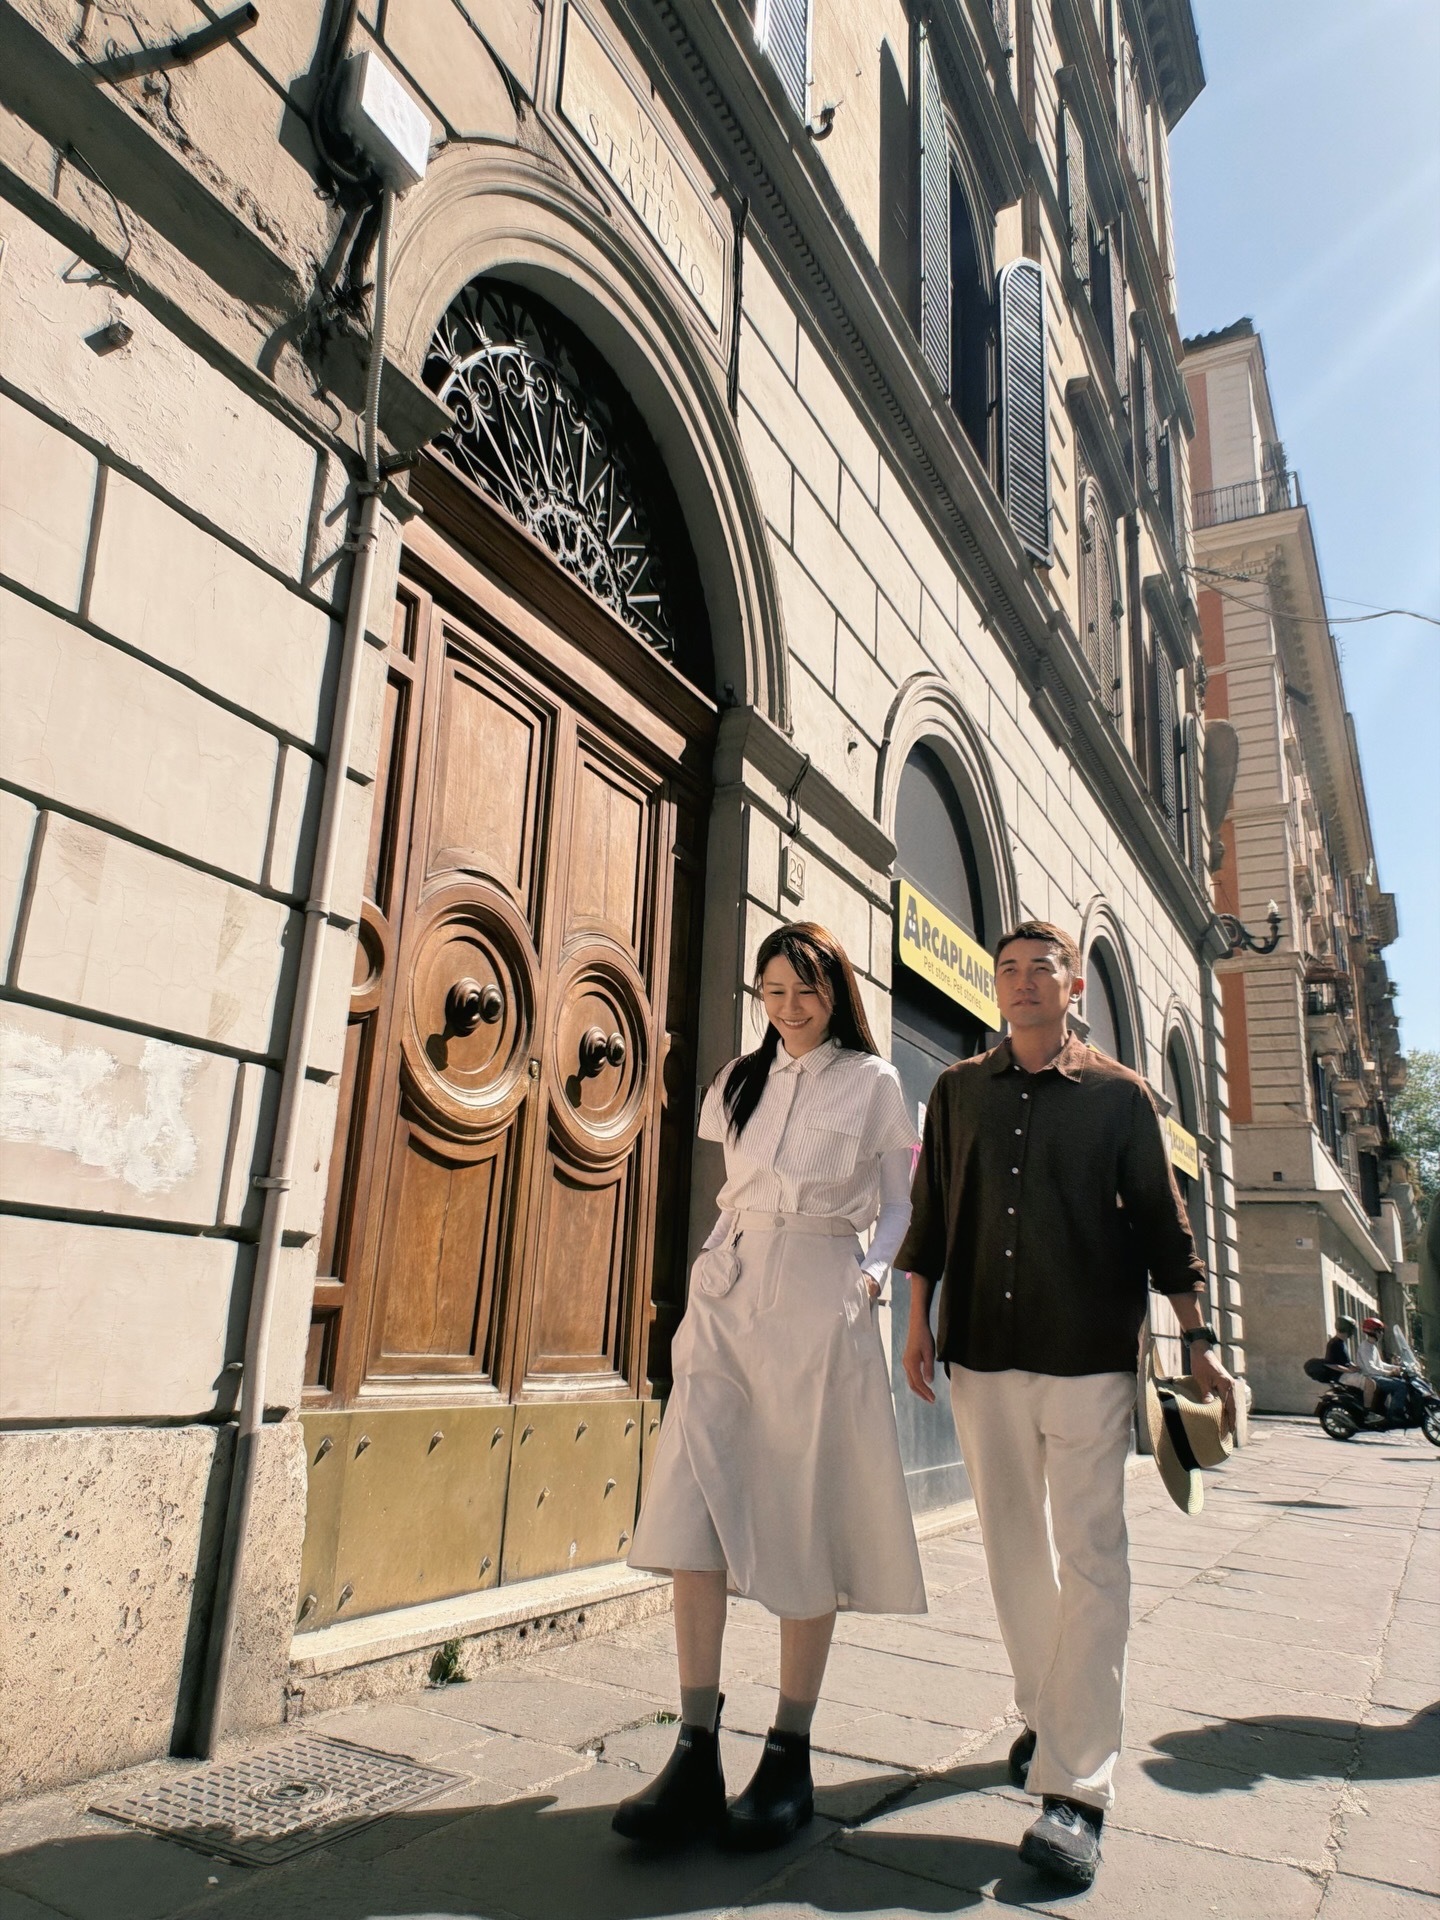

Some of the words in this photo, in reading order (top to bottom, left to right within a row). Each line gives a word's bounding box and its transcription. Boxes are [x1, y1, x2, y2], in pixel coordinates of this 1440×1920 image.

[629, 138, 679, 222] DELLO
[637, 109, 674, 191] VIA
[586, 114, 705, 296] STATUTO
[790, 858, 804, 888] 29
[903, 894, 995, 1003] ARCAPLANET
[923, 955, 934, 975] Pet
[953, 978, 963, 996] Pet
